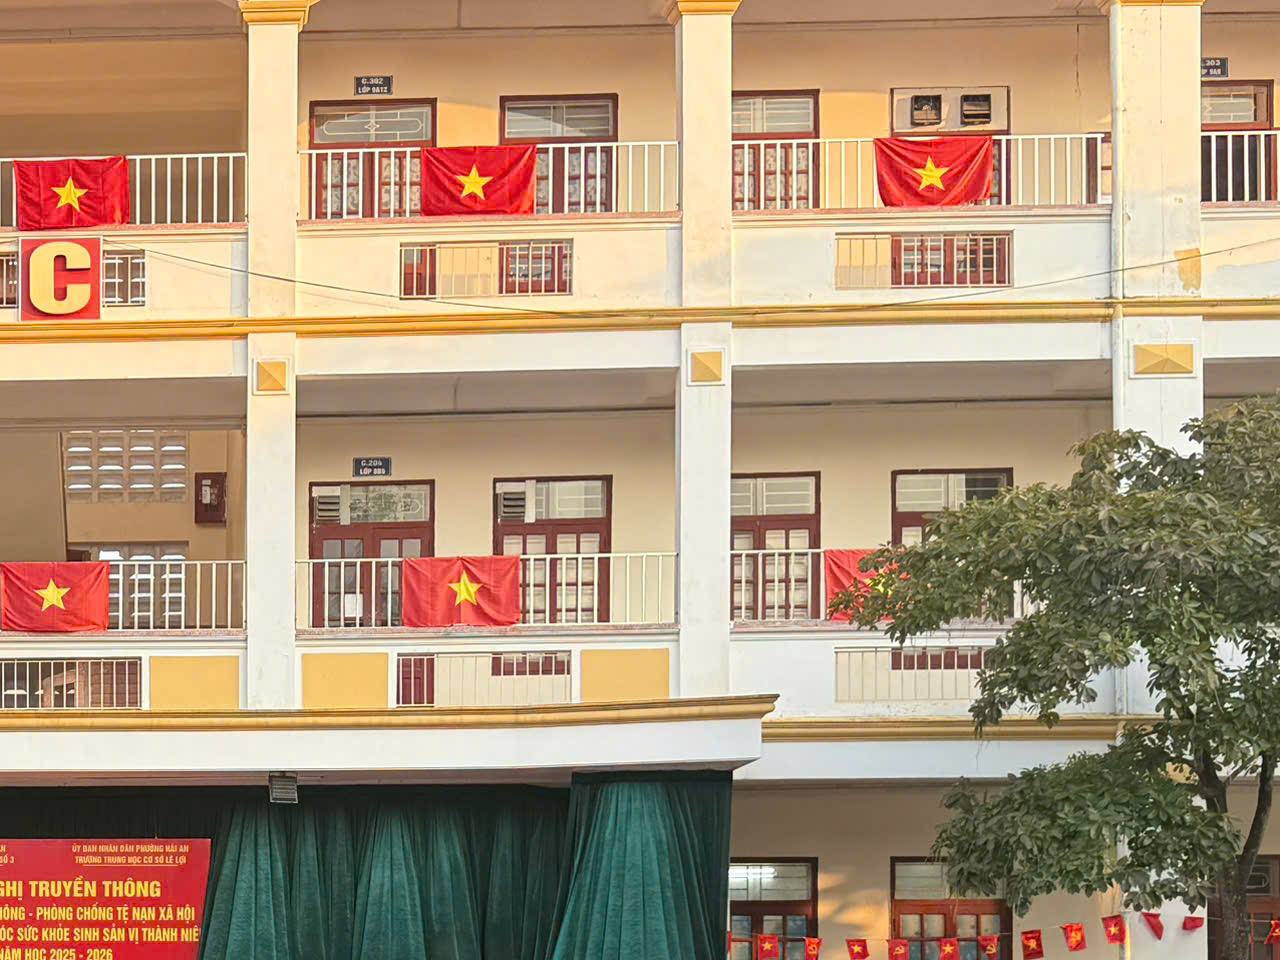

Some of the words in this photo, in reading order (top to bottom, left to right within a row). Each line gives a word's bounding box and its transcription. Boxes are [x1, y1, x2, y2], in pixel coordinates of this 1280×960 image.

[30, 242, 91, 314] C
[99, 844, 118, 852] NHÂN
[29, 876, 96, 897] TRUYỀN
[102, 878, 161, 897] THÔNG
[36, 904, 72, 920] PHÒNG
[76, 902, 113, 920] CHỐNG
[116, 904, 128, 924] TỆ
[132, 906, 155, 924] NẠN
[159, 904, 173, 920] XÃ
[176, 904, 195, 924] HỘI
[17, 925, 38, 941] SỨC
[42, 923, 70, 941] KHỎE
[73, 928, 99, 942] SINH
[103, 923, 125, 941] SẢN
[128, 928, 139, 944] VỊ
[142, 925, 177, 942] THÀNH
[181, 925, 201, 942] NIÊ
